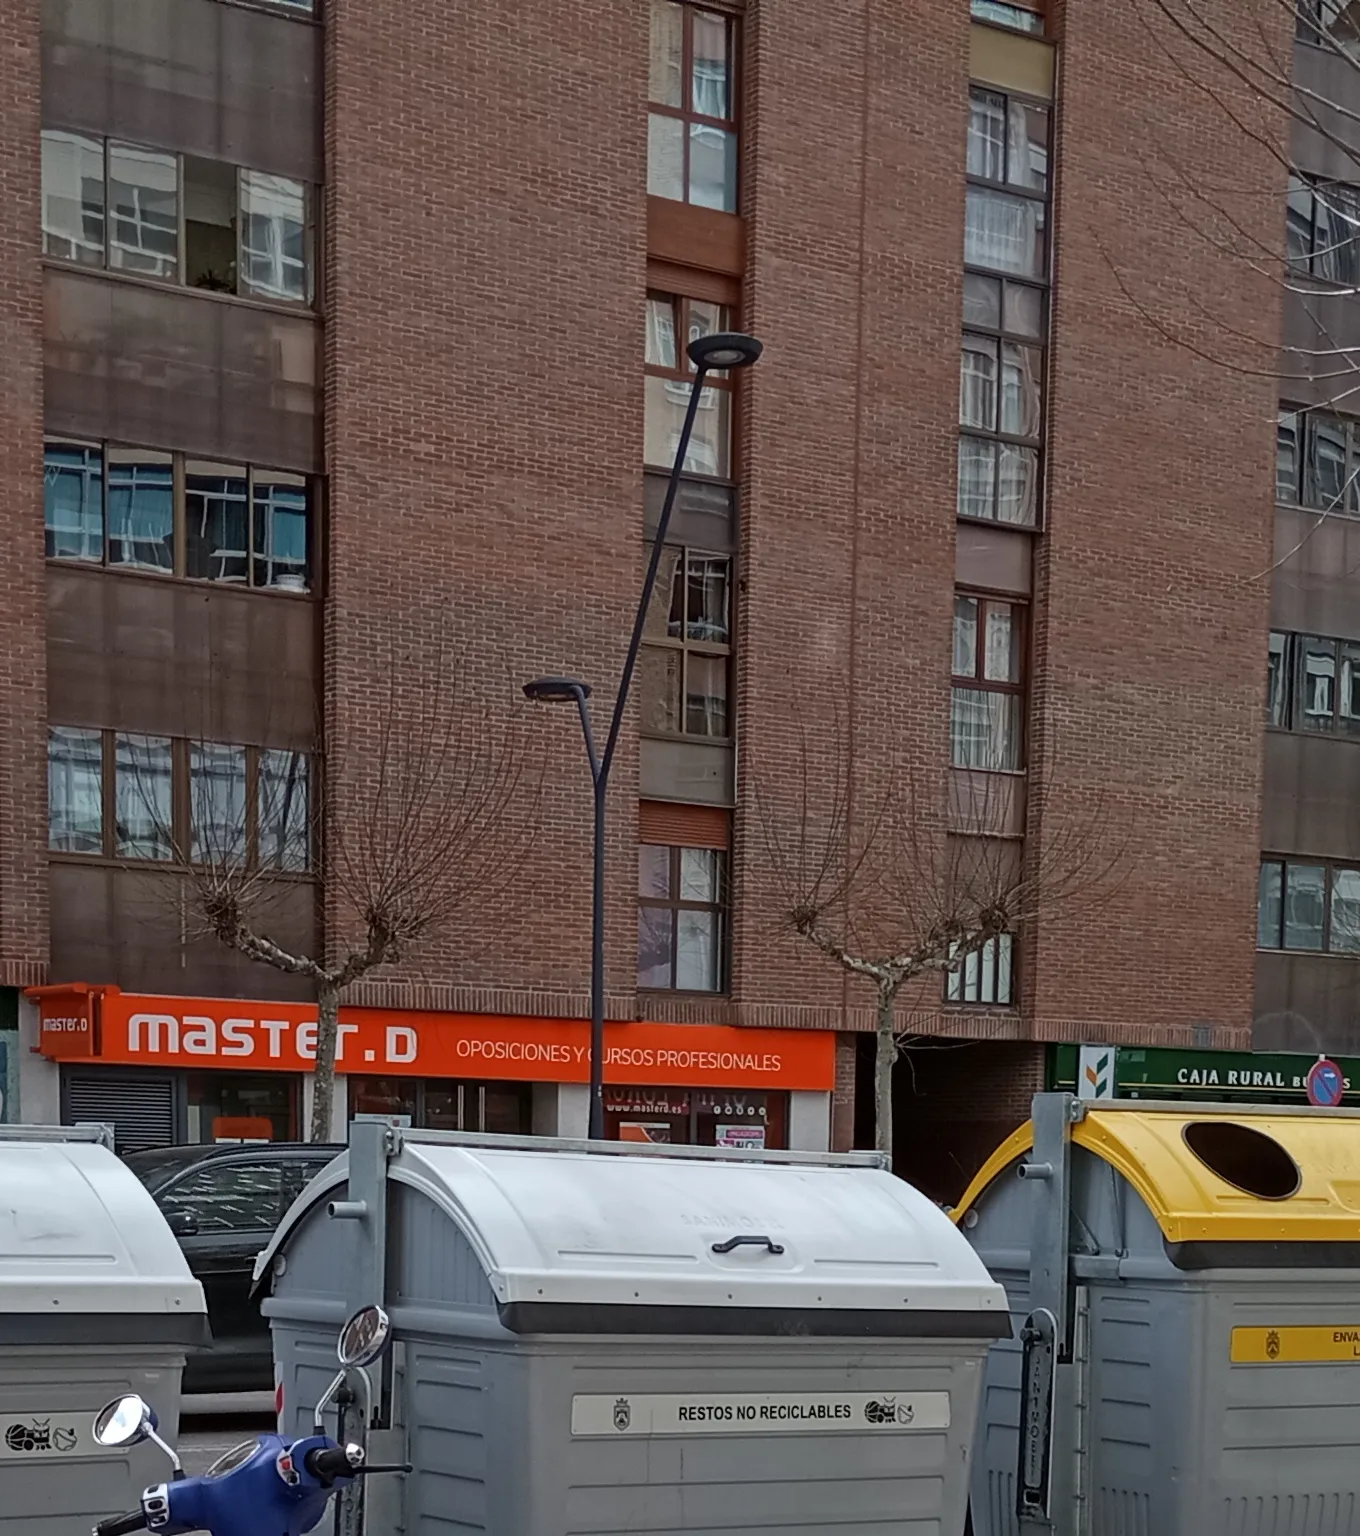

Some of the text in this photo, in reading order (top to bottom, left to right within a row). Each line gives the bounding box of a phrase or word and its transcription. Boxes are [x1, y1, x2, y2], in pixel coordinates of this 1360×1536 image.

[456, 1039, 570, 1063] OPOSICIONES
[574, 1047, 586, 1063] Y
[657, 1050, 782, 1072] PROFESIONALES
[1177, 1068, 1219, 1086] CAJA
[1228, 1069, 1285, 1087] RURAL
[678, 1404, 851, 1421] RESTOS NO RECICLABLES
